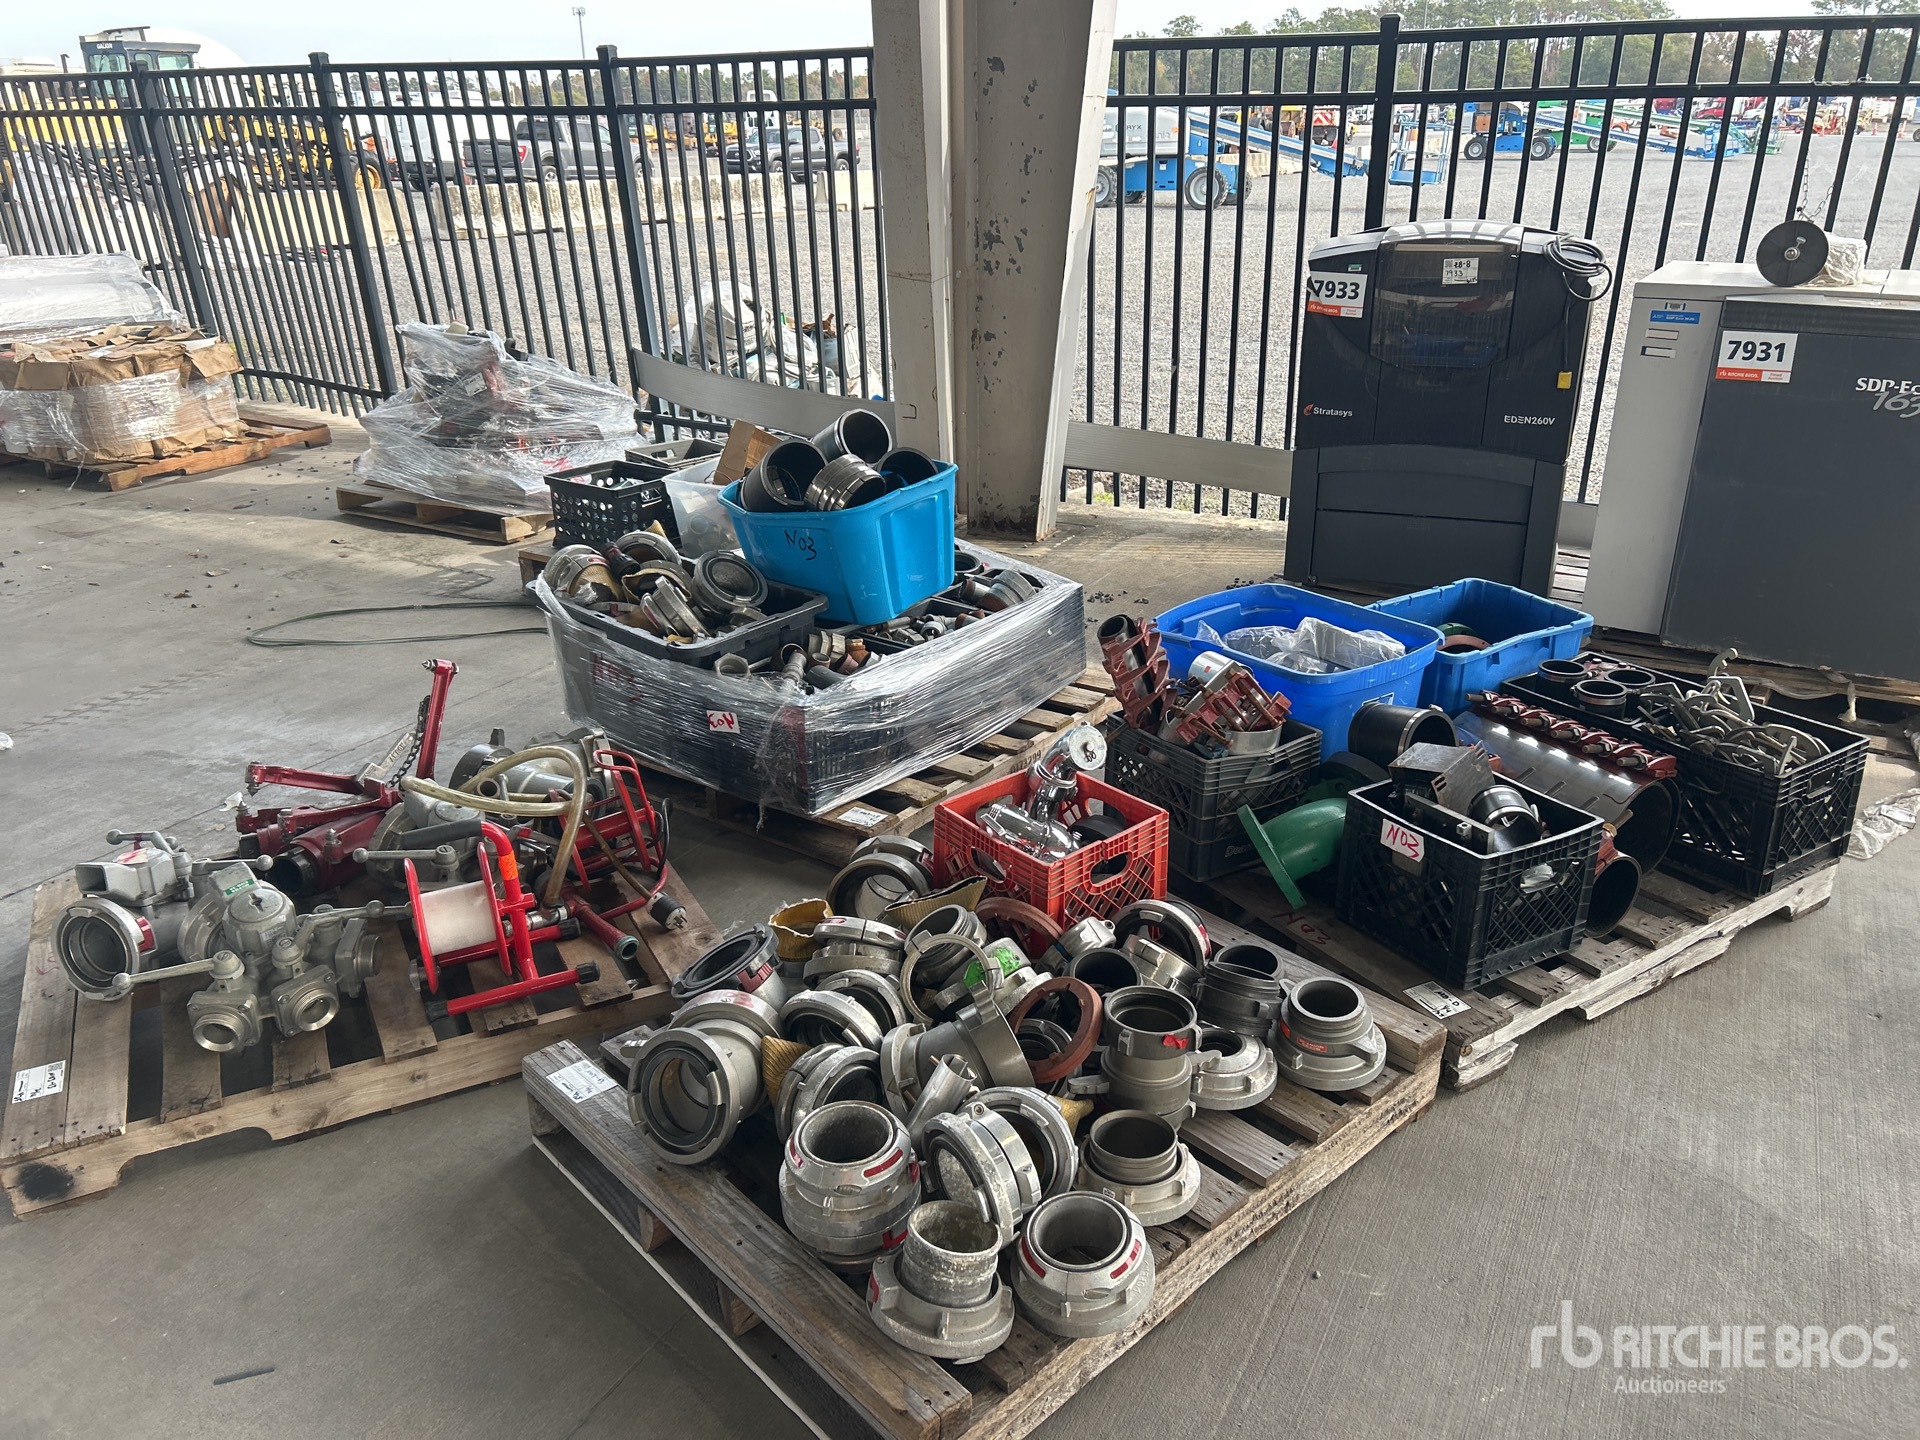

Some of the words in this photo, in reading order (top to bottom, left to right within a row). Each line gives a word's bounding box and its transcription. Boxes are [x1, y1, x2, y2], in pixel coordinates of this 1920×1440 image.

[1313, 279, 1360, 300] 7933
[1727, 340, 1786, 362] 7931
[1313, 406, 1353, 418] Stratasys
[1503, 414, 1556, 426] EDEN260V
